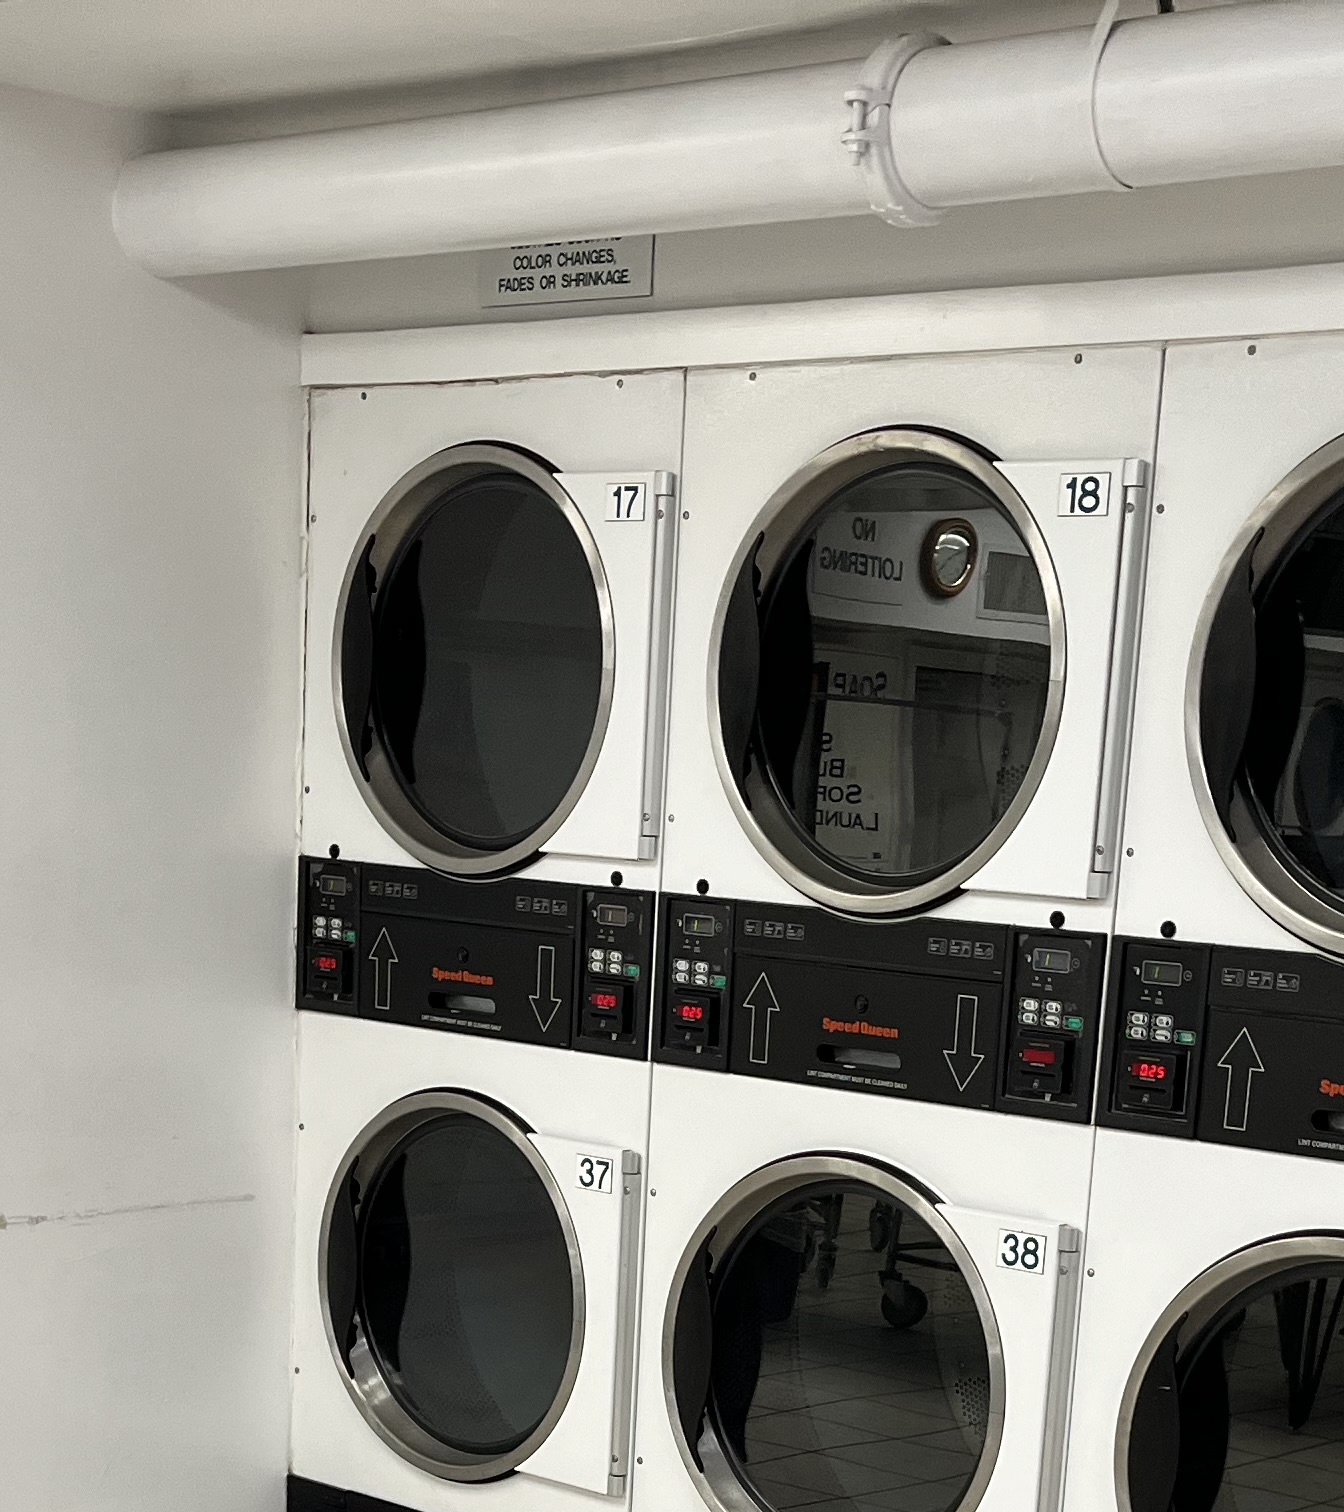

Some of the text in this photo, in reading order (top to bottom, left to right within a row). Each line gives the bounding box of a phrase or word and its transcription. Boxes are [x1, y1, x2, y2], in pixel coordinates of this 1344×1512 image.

[513, 248, 617, 271] COLOR CHANGES,
[498, 276, 535, 294] FADES
[539, 275, 556, 290] OR
[613, 486, 639, 518] 17
[1066, 476, 1100, 513] 18
[822, 1017, 899, 1038] Speed Queen
[579, 1158, 609, 1189] 37
[1002, 1233, 1039, 1269] 38
